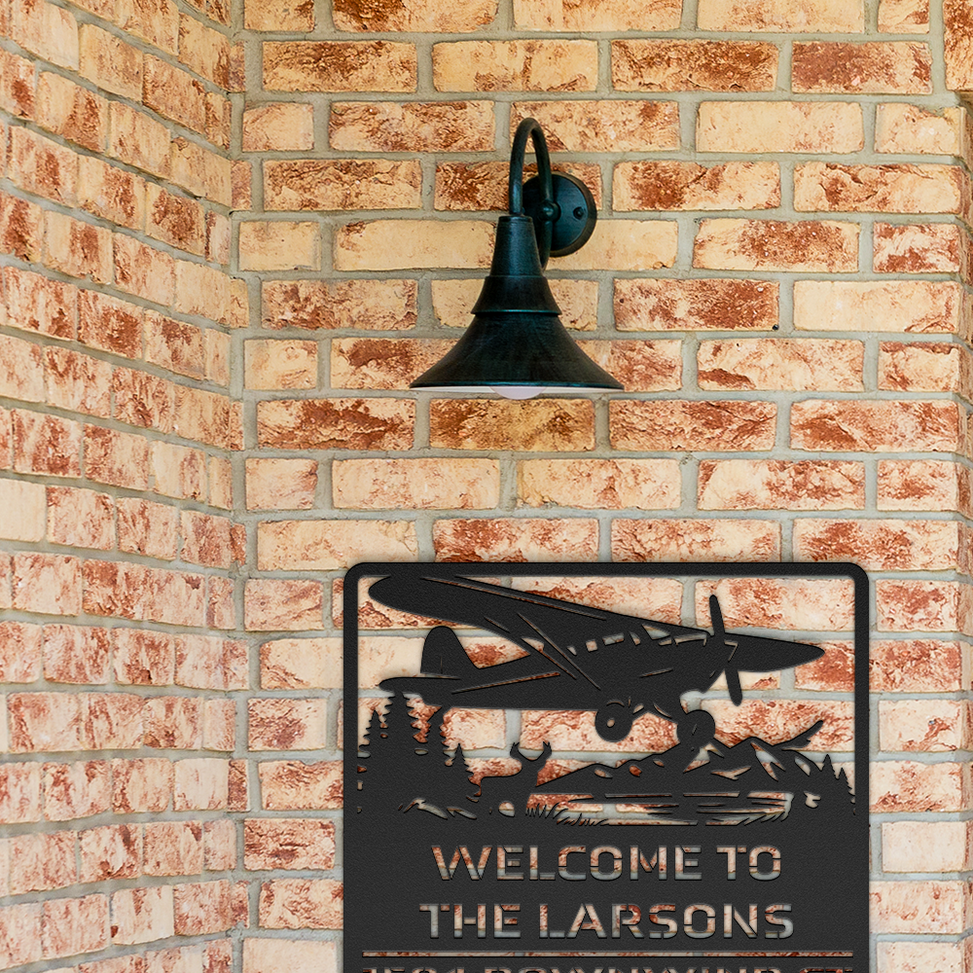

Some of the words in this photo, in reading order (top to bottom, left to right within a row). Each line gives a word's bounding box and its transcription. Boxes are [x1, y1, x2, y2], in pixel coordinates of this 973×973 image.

[431, 845, 702, 881] WELCOME
[716, 845, 782, 880] TO
[419, 903, 521, 938] THE
[538, 903, 794, 939] LARSONS
